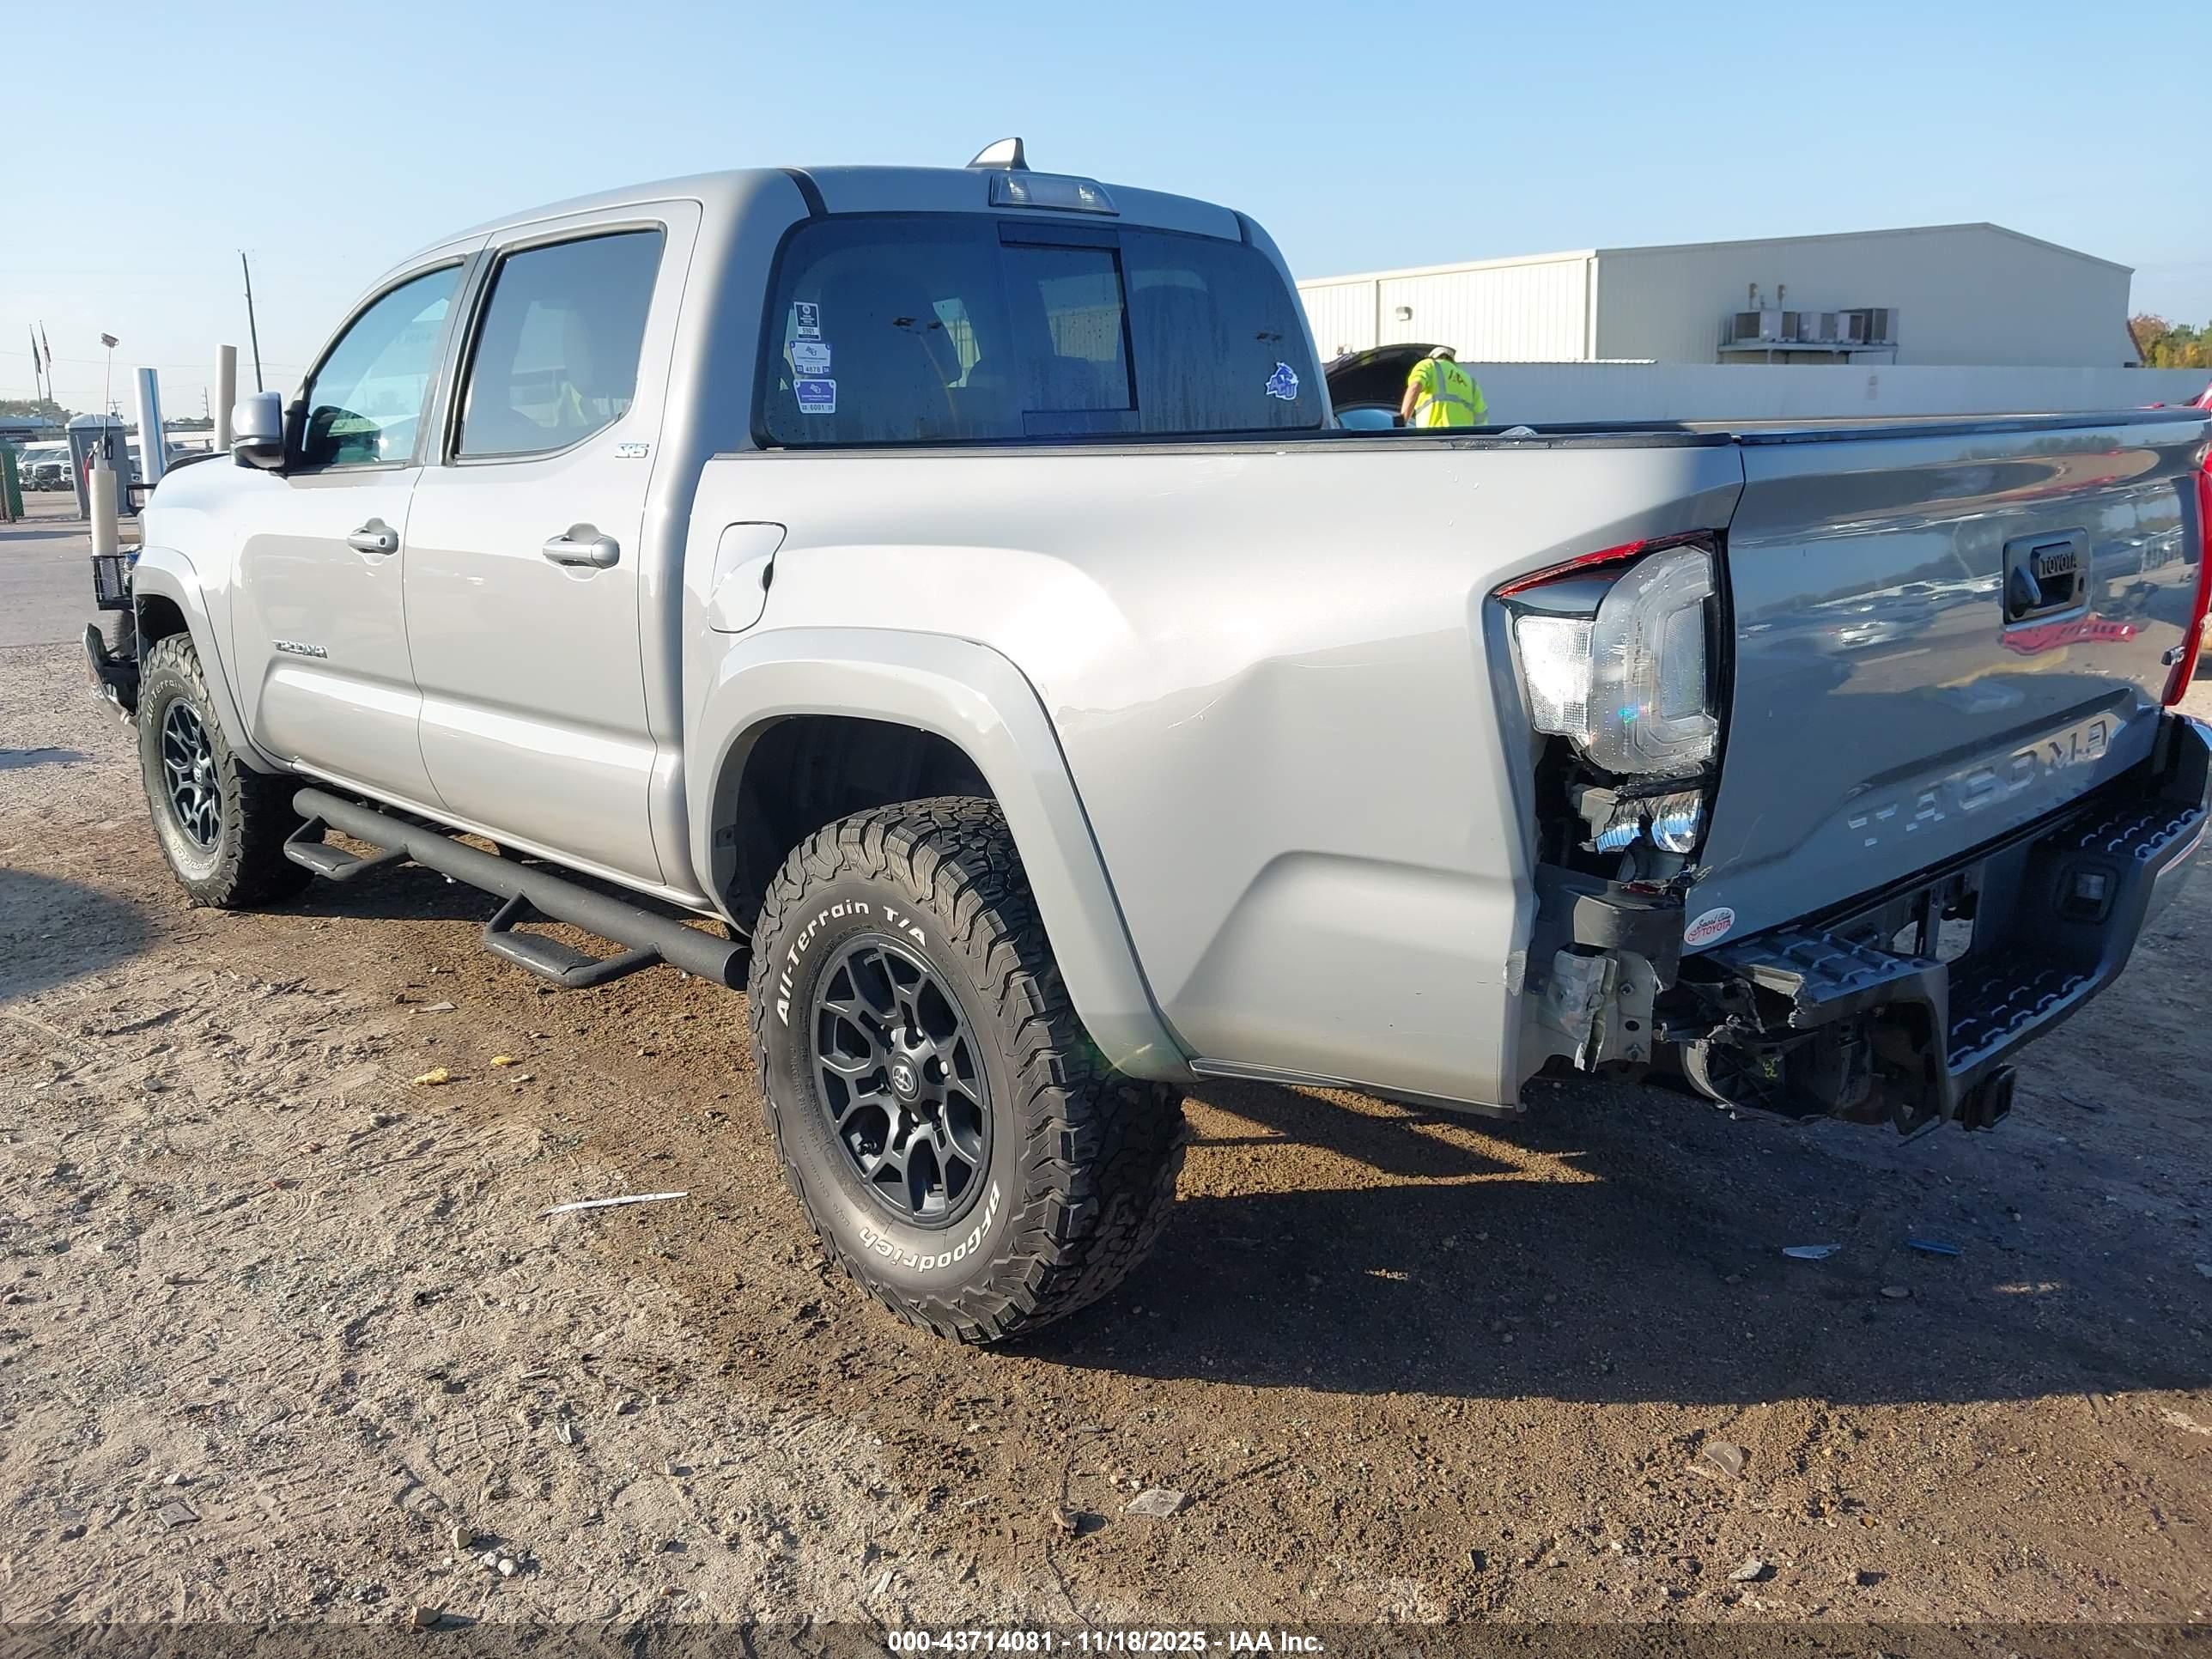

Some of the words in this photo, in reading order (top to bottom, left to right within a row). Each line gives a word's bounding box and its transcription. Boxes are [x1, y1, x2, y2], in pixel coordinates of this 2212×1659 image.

[1269, 378, 1294, 397] ACU
[615, 441, 650, 459] SR5
[2039, 551, 2077, 574] TOYOTA
[1703, 919, 1732, 937] TOYOTA
[776, 899, 871, 1028] All-Terrain
[882, 904, 928, 948] T/A
[859, 1181, 1001, 1273] BFGoodrich
